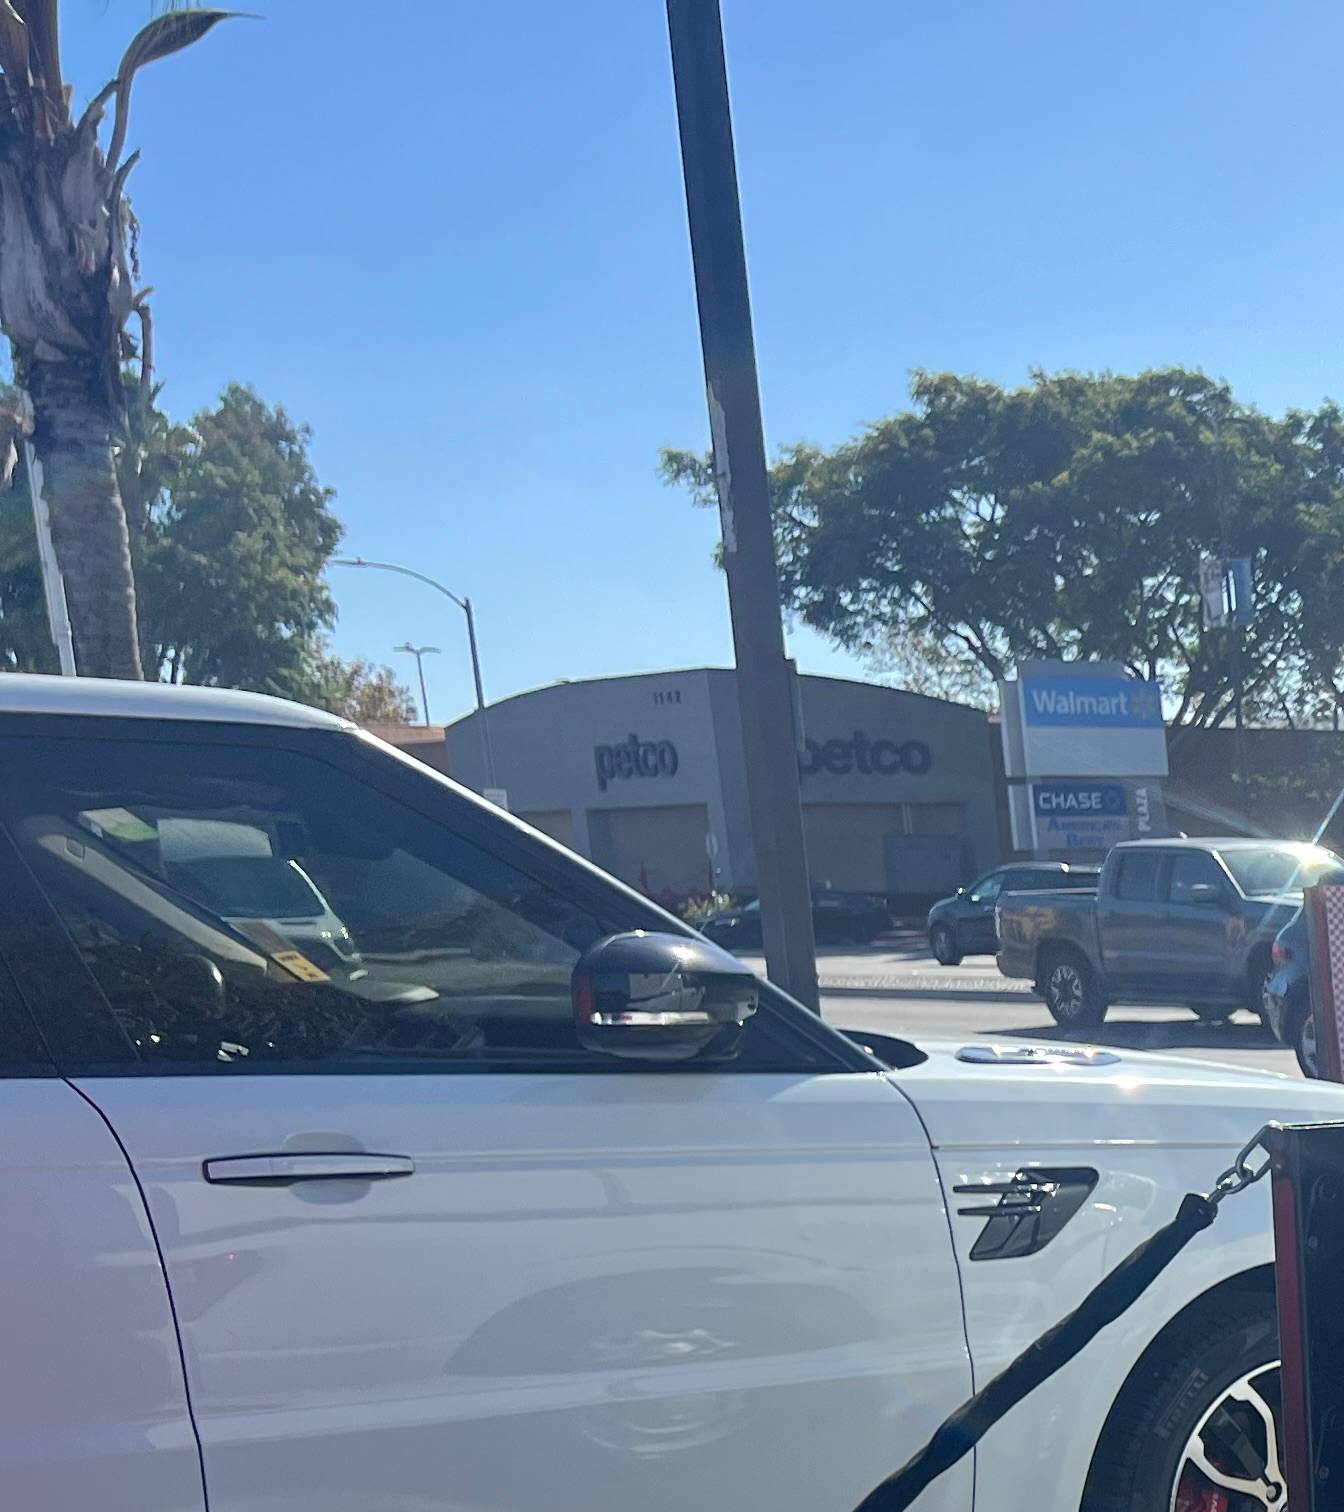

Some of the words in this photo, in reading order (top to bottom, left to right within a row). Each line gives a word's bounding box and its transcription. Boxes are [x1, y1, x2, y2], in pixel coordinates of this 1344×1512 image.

[1033, 689, 1128, 715] Walmart
[594, 733, 679, 792] petco
[1039, 792, 1103, 809] CHASE
[1135, 788, 1151, 832] PLAZA
